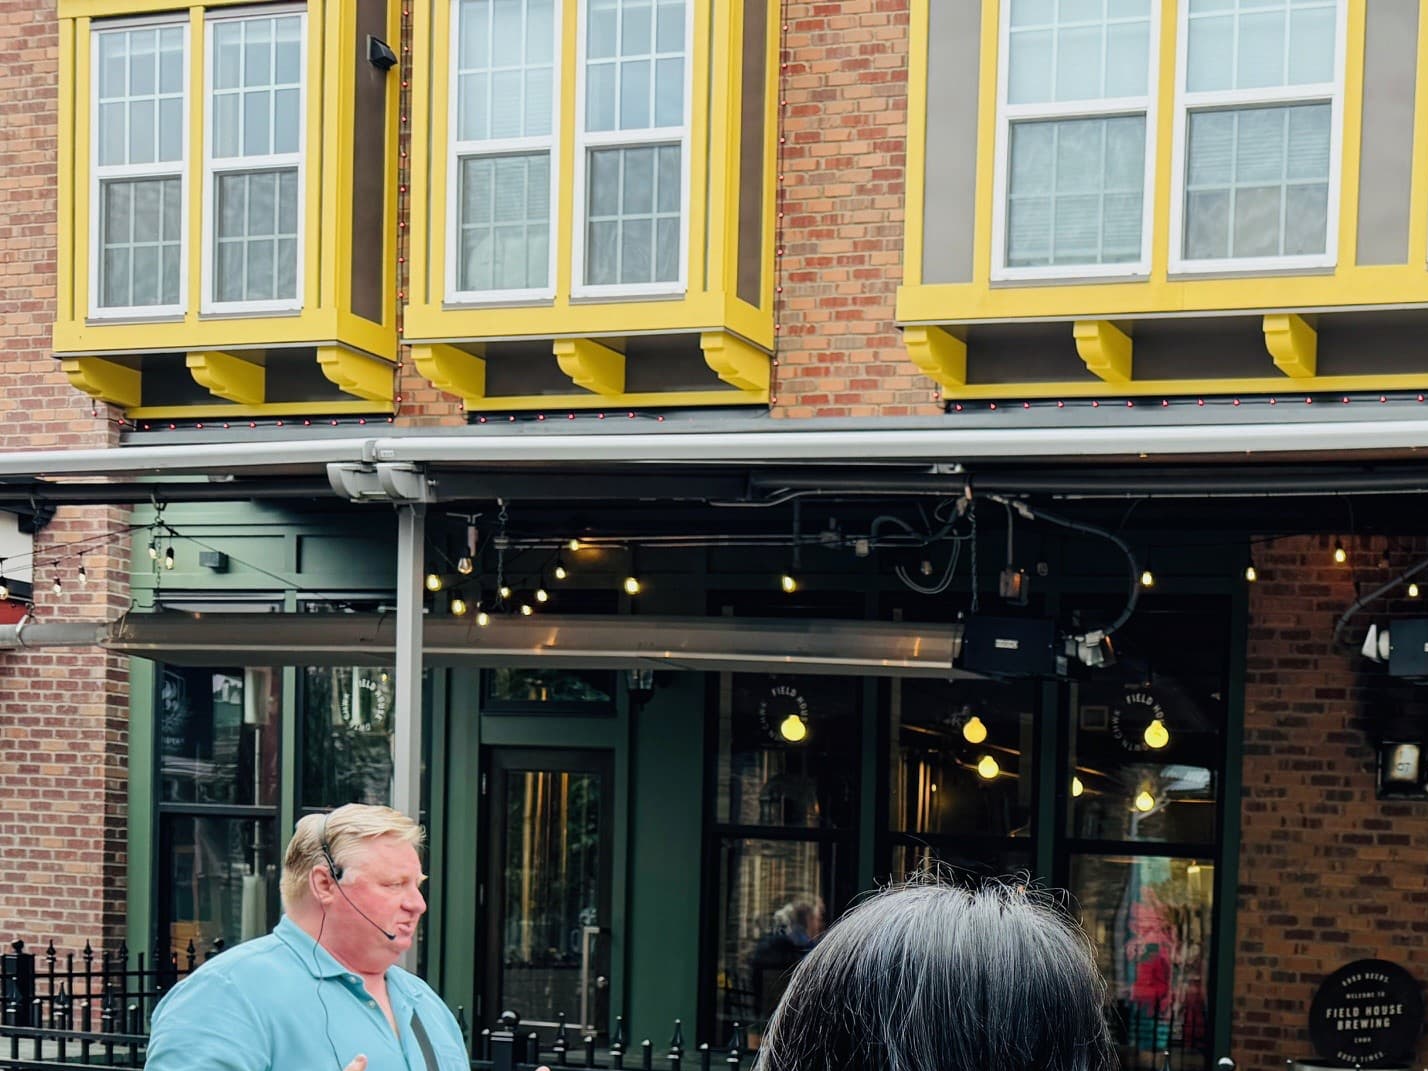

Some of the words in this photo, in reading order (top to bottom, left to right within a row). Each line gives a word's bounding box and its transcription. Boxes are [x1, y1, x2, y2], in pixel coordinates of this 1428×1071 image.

[770, 685, 798, 697] FIELD
[1125, 692, 1154, 706] FIELD
[1341, 973, 1363, 987] GOOD
[1345, 991, 1375, 1000] WELCOME
[1377, 990, 1386, 999] TO
[1325, 1006, 1360, 1020] FIELD
[1364, 1003, 1404, 1018] HOUSE
[1336, 1017, 1392, 1031] BREWING
[1336, 1050, 1358, 1063] GOOD
